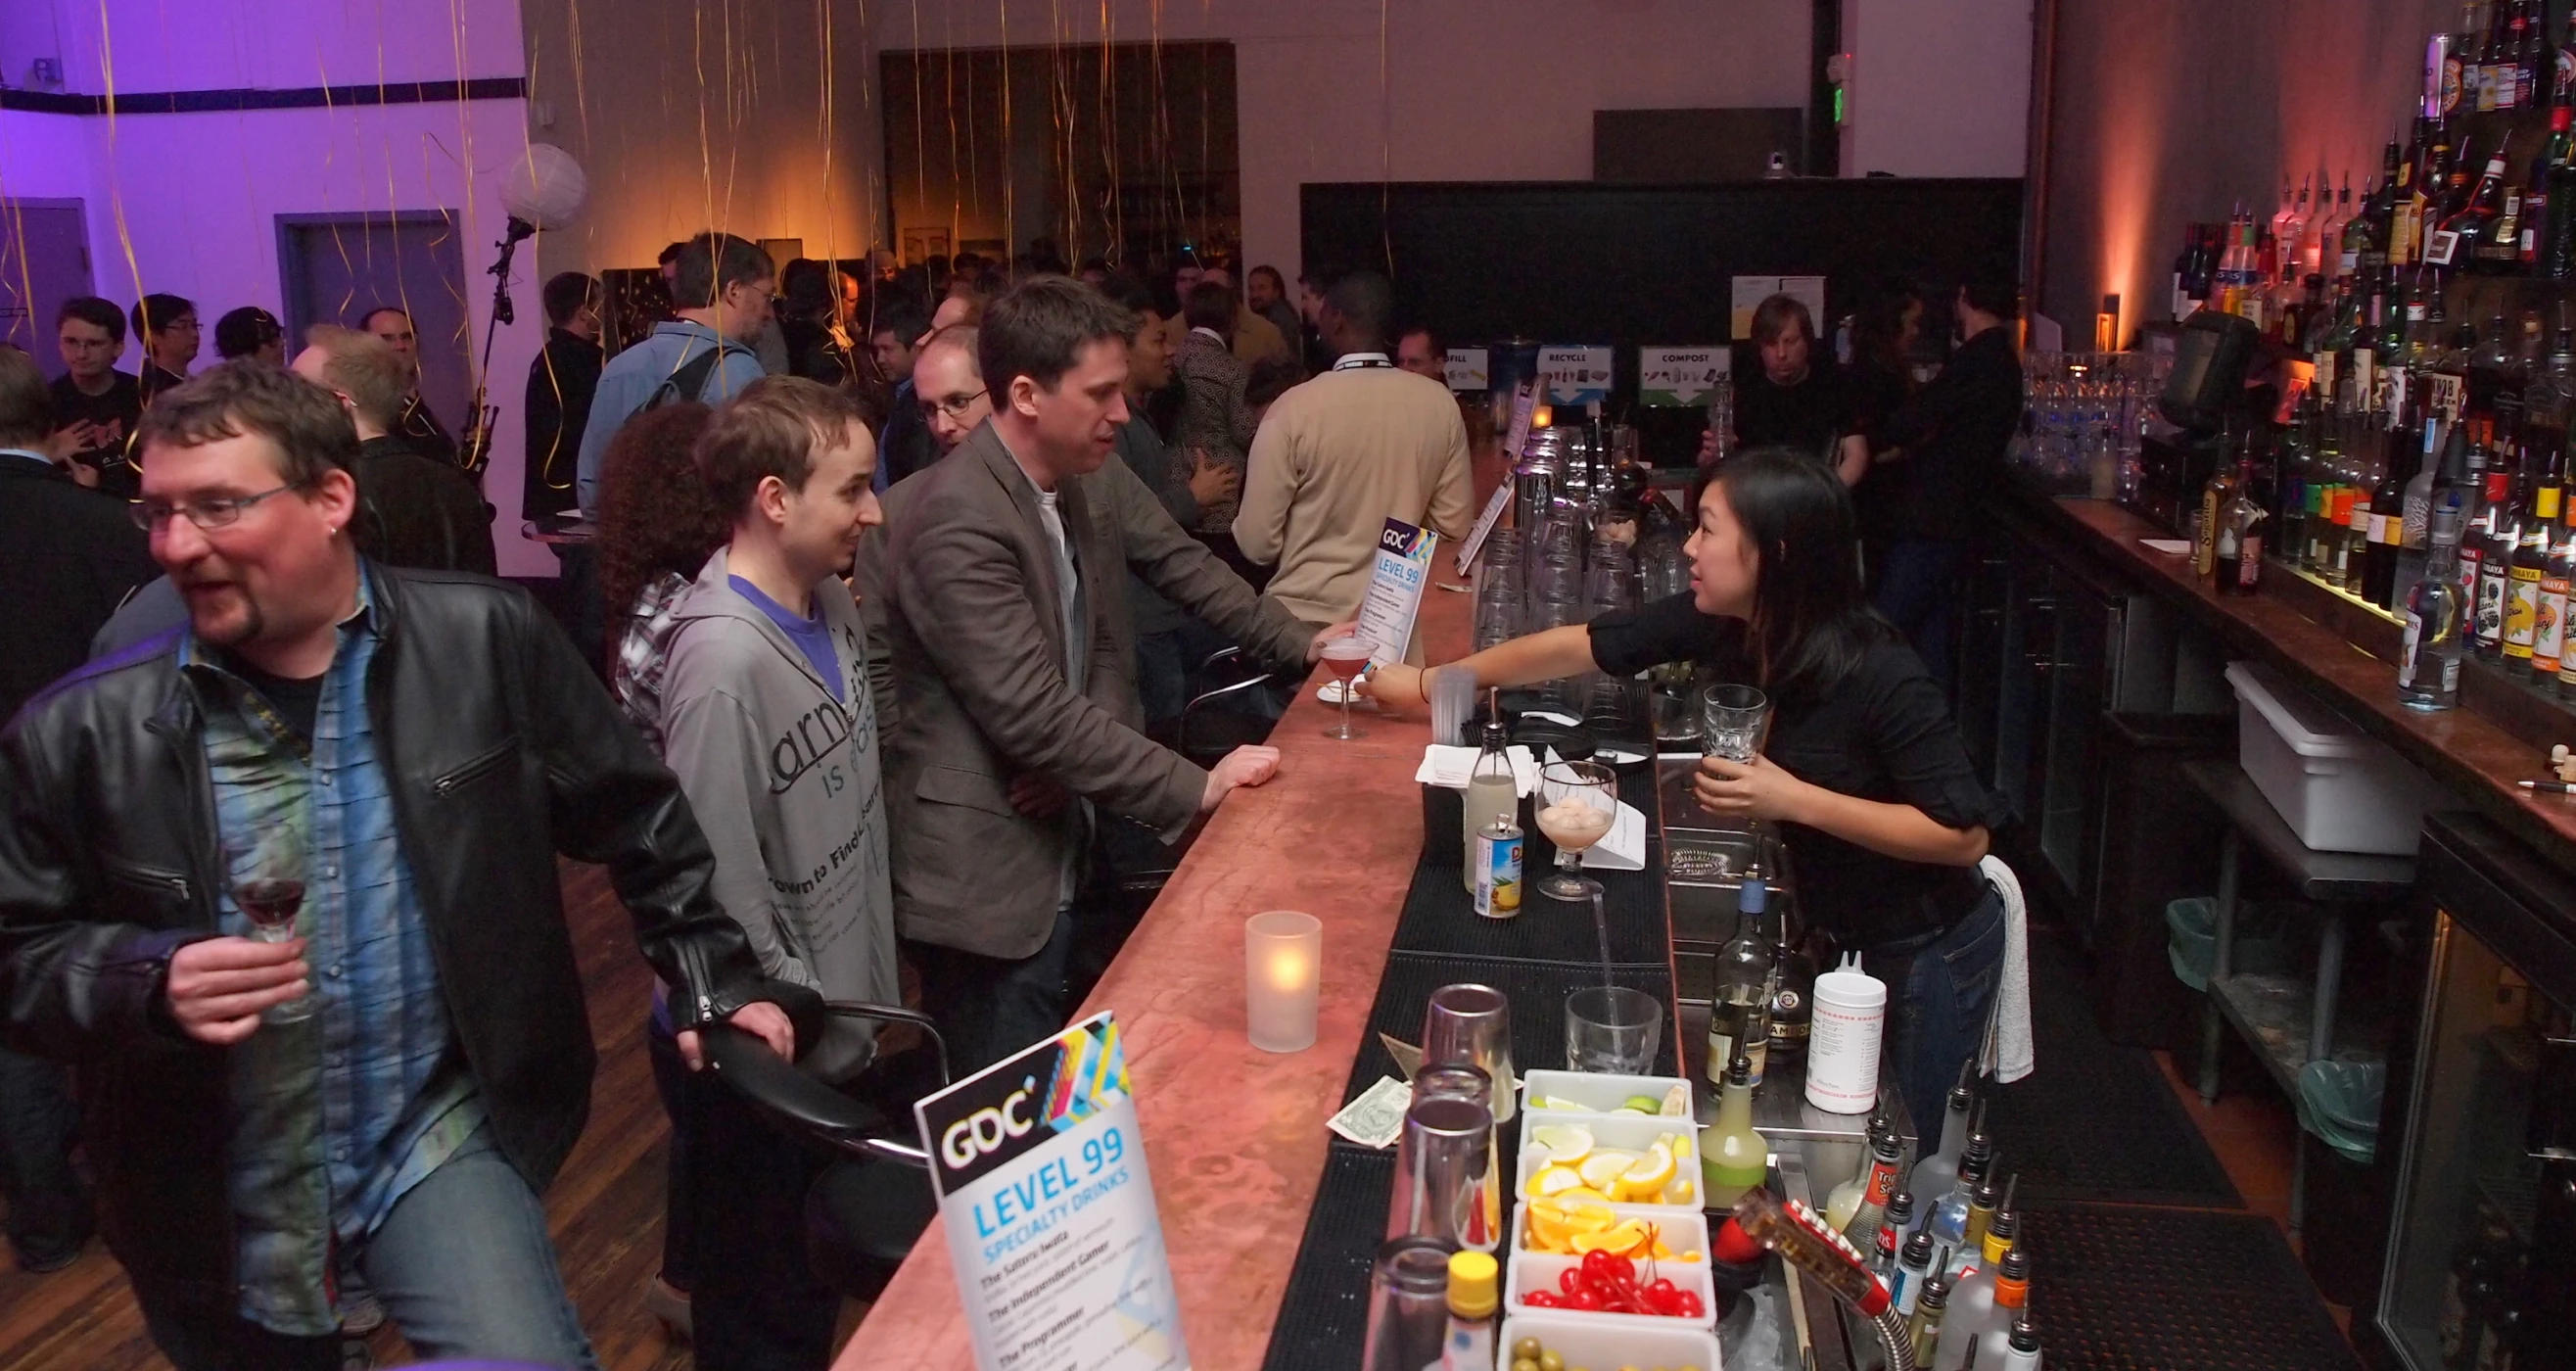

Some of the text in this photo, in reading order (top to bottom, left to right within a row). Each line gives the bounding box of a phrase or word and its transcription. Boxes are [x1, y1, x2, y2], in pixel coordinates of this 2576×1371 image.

[1549, 354, 1586, 362] RECYCLE
[1382, 528, 1407, 549] GDC
[1376, 571, 1398, 587] SPECIALTY
[1379, 556, 1419, 584] LEVEL 99
[817, 762, 845, 799] is
[768, 876, 815, 894] own
[814, 865, 827, 883] to
[829, 834, 859, 870] Find
[941, 1089, 1034, 1169] GDC
[971, 1127, 1125, 1239] LEVEL 99
[981, 1202, 1069, 1264] SPECIALTY
[1071, 1167, 1130, 1211] DRINKS
[980, 1272, 1003, 1289] The
[988, 1240, 1110, 1322] The Independent Gamer
[999, 1350, 1019, 1368] The
[1020, 1306, 1085, 1353] Programmer
